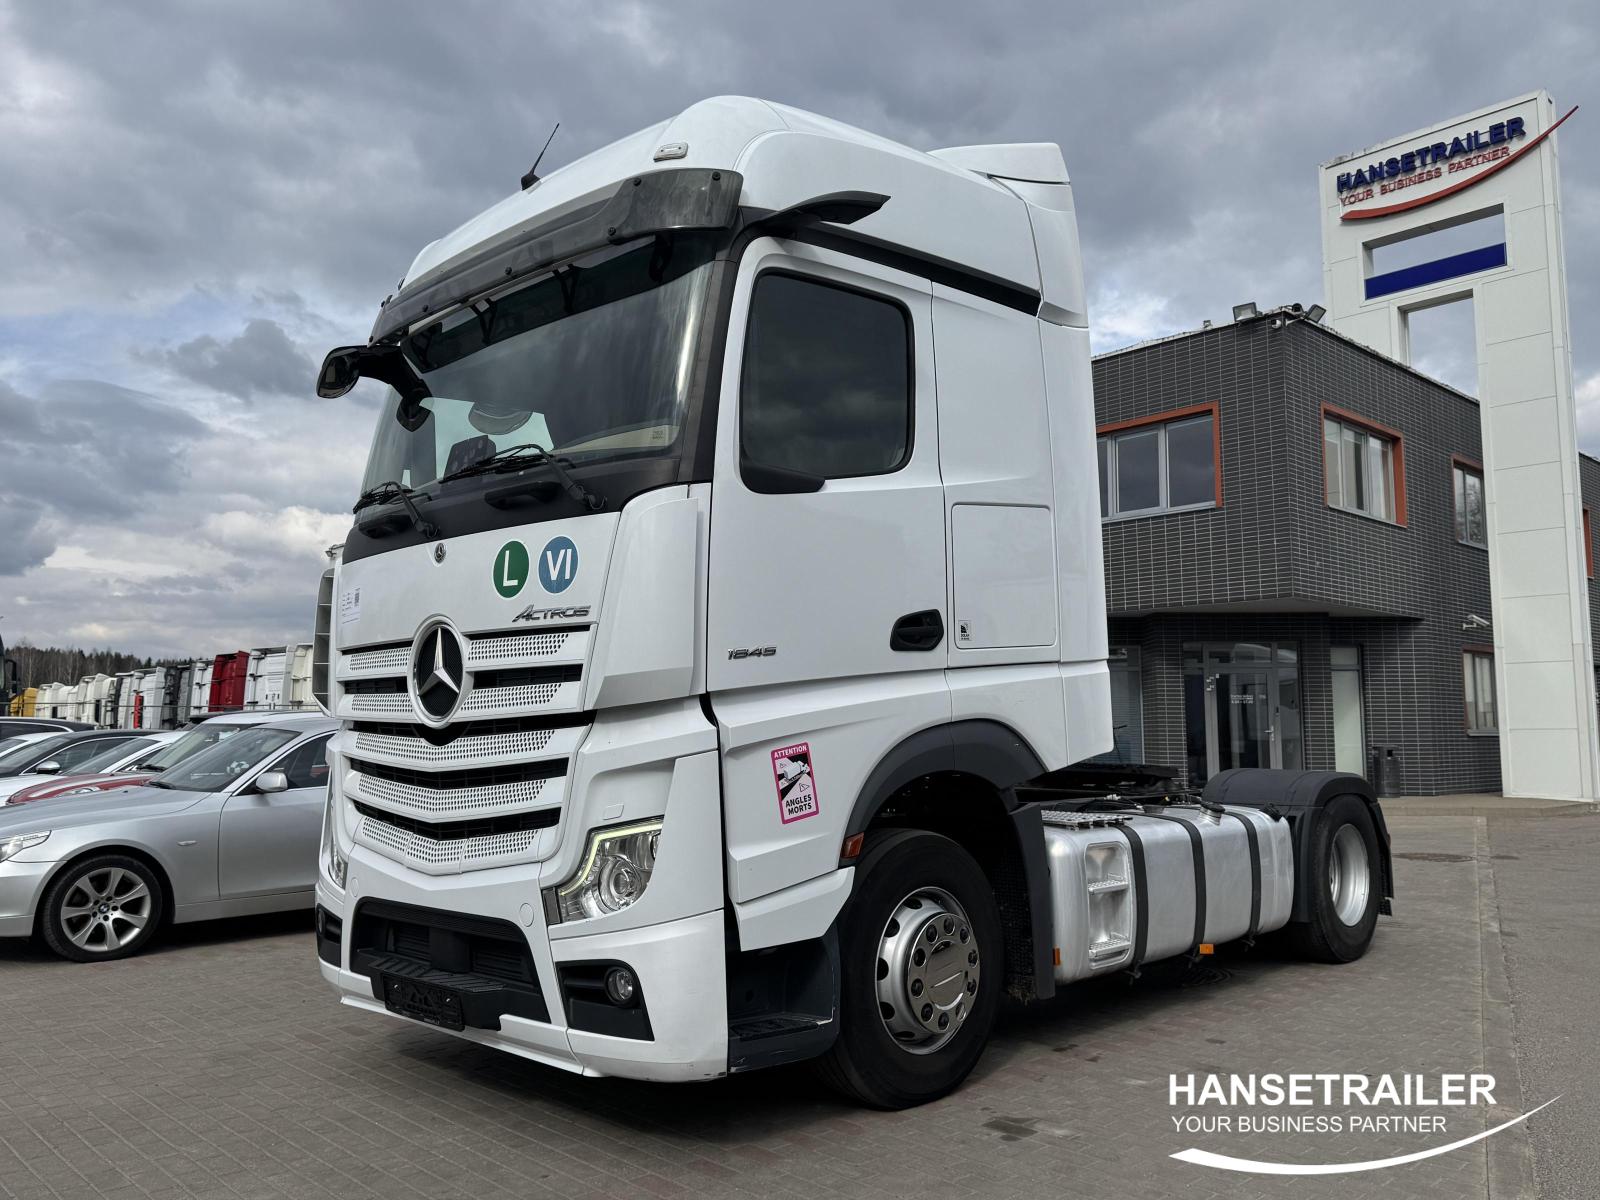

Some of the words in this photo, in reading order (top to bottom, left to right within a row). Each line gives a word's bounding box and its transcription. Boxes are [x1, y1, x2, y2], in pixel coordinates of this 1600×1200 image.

[1337, 116, 1527, 193] HANSETRAILER
[1340, 188, 1374, 206] YOUR
[1380, 168, 1442, 195] BUSINESS
[1448, 146, 1511, 174] PARTNER
[503, 550, 518, 587] L
[546, 548, 573, 581] VI
[727, 646, 777, 660] 1845
[774, 744, 808, 759] ATTENTION
[785, 794, 812, 808] ANGLES
[788, 803, 812, 815] MORTS
